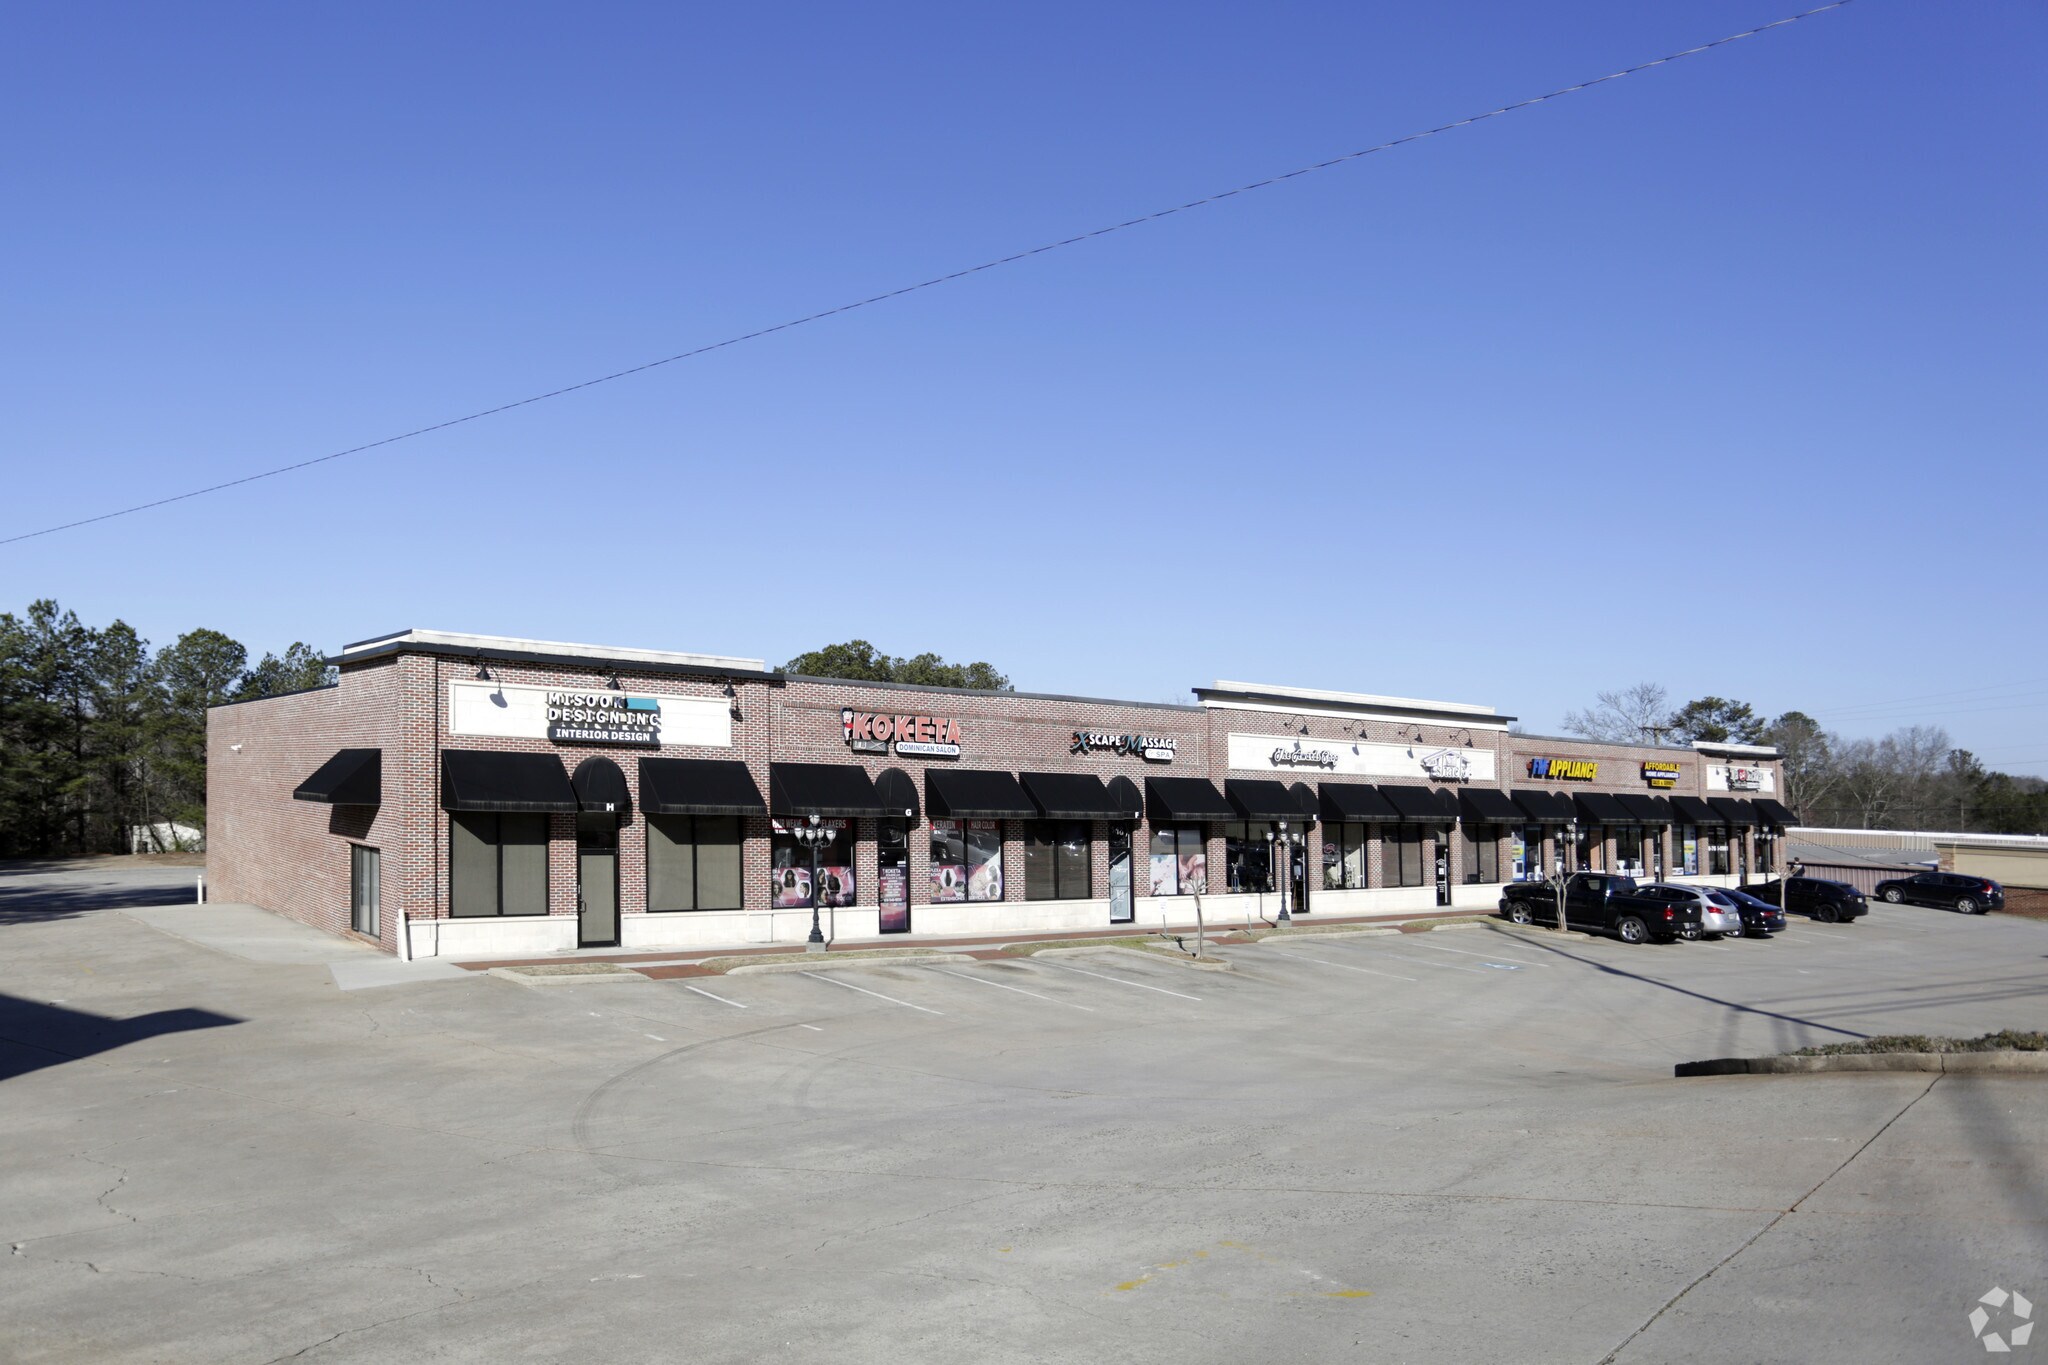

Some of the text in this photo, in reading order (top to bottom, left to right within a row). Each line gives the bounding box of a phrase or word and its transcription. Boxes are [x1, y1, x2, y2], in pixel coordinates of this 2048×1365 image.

[548, 692, 623, 709] MISOOK
[548, 708, 659, 726] DESIGN INC
[852, 712, 960, 744] KOKETA
[556, 728, 650, 742] INTERIOR DESIGN
[900, 743, 957, 753] DOMINICAN SALON
[1120, 734, 1178, 752] MASSAGE
[1156, 750, 1170, 758] SPA
[1549, 760, 1599, 778] APPLIANCE
[1645, 762, 1680, 773] AFFORDABLE
[606, 803, 614, 811] H
[905, 808, 912, 816] G
[970, 820, 996, 830] HAIR COLOR
